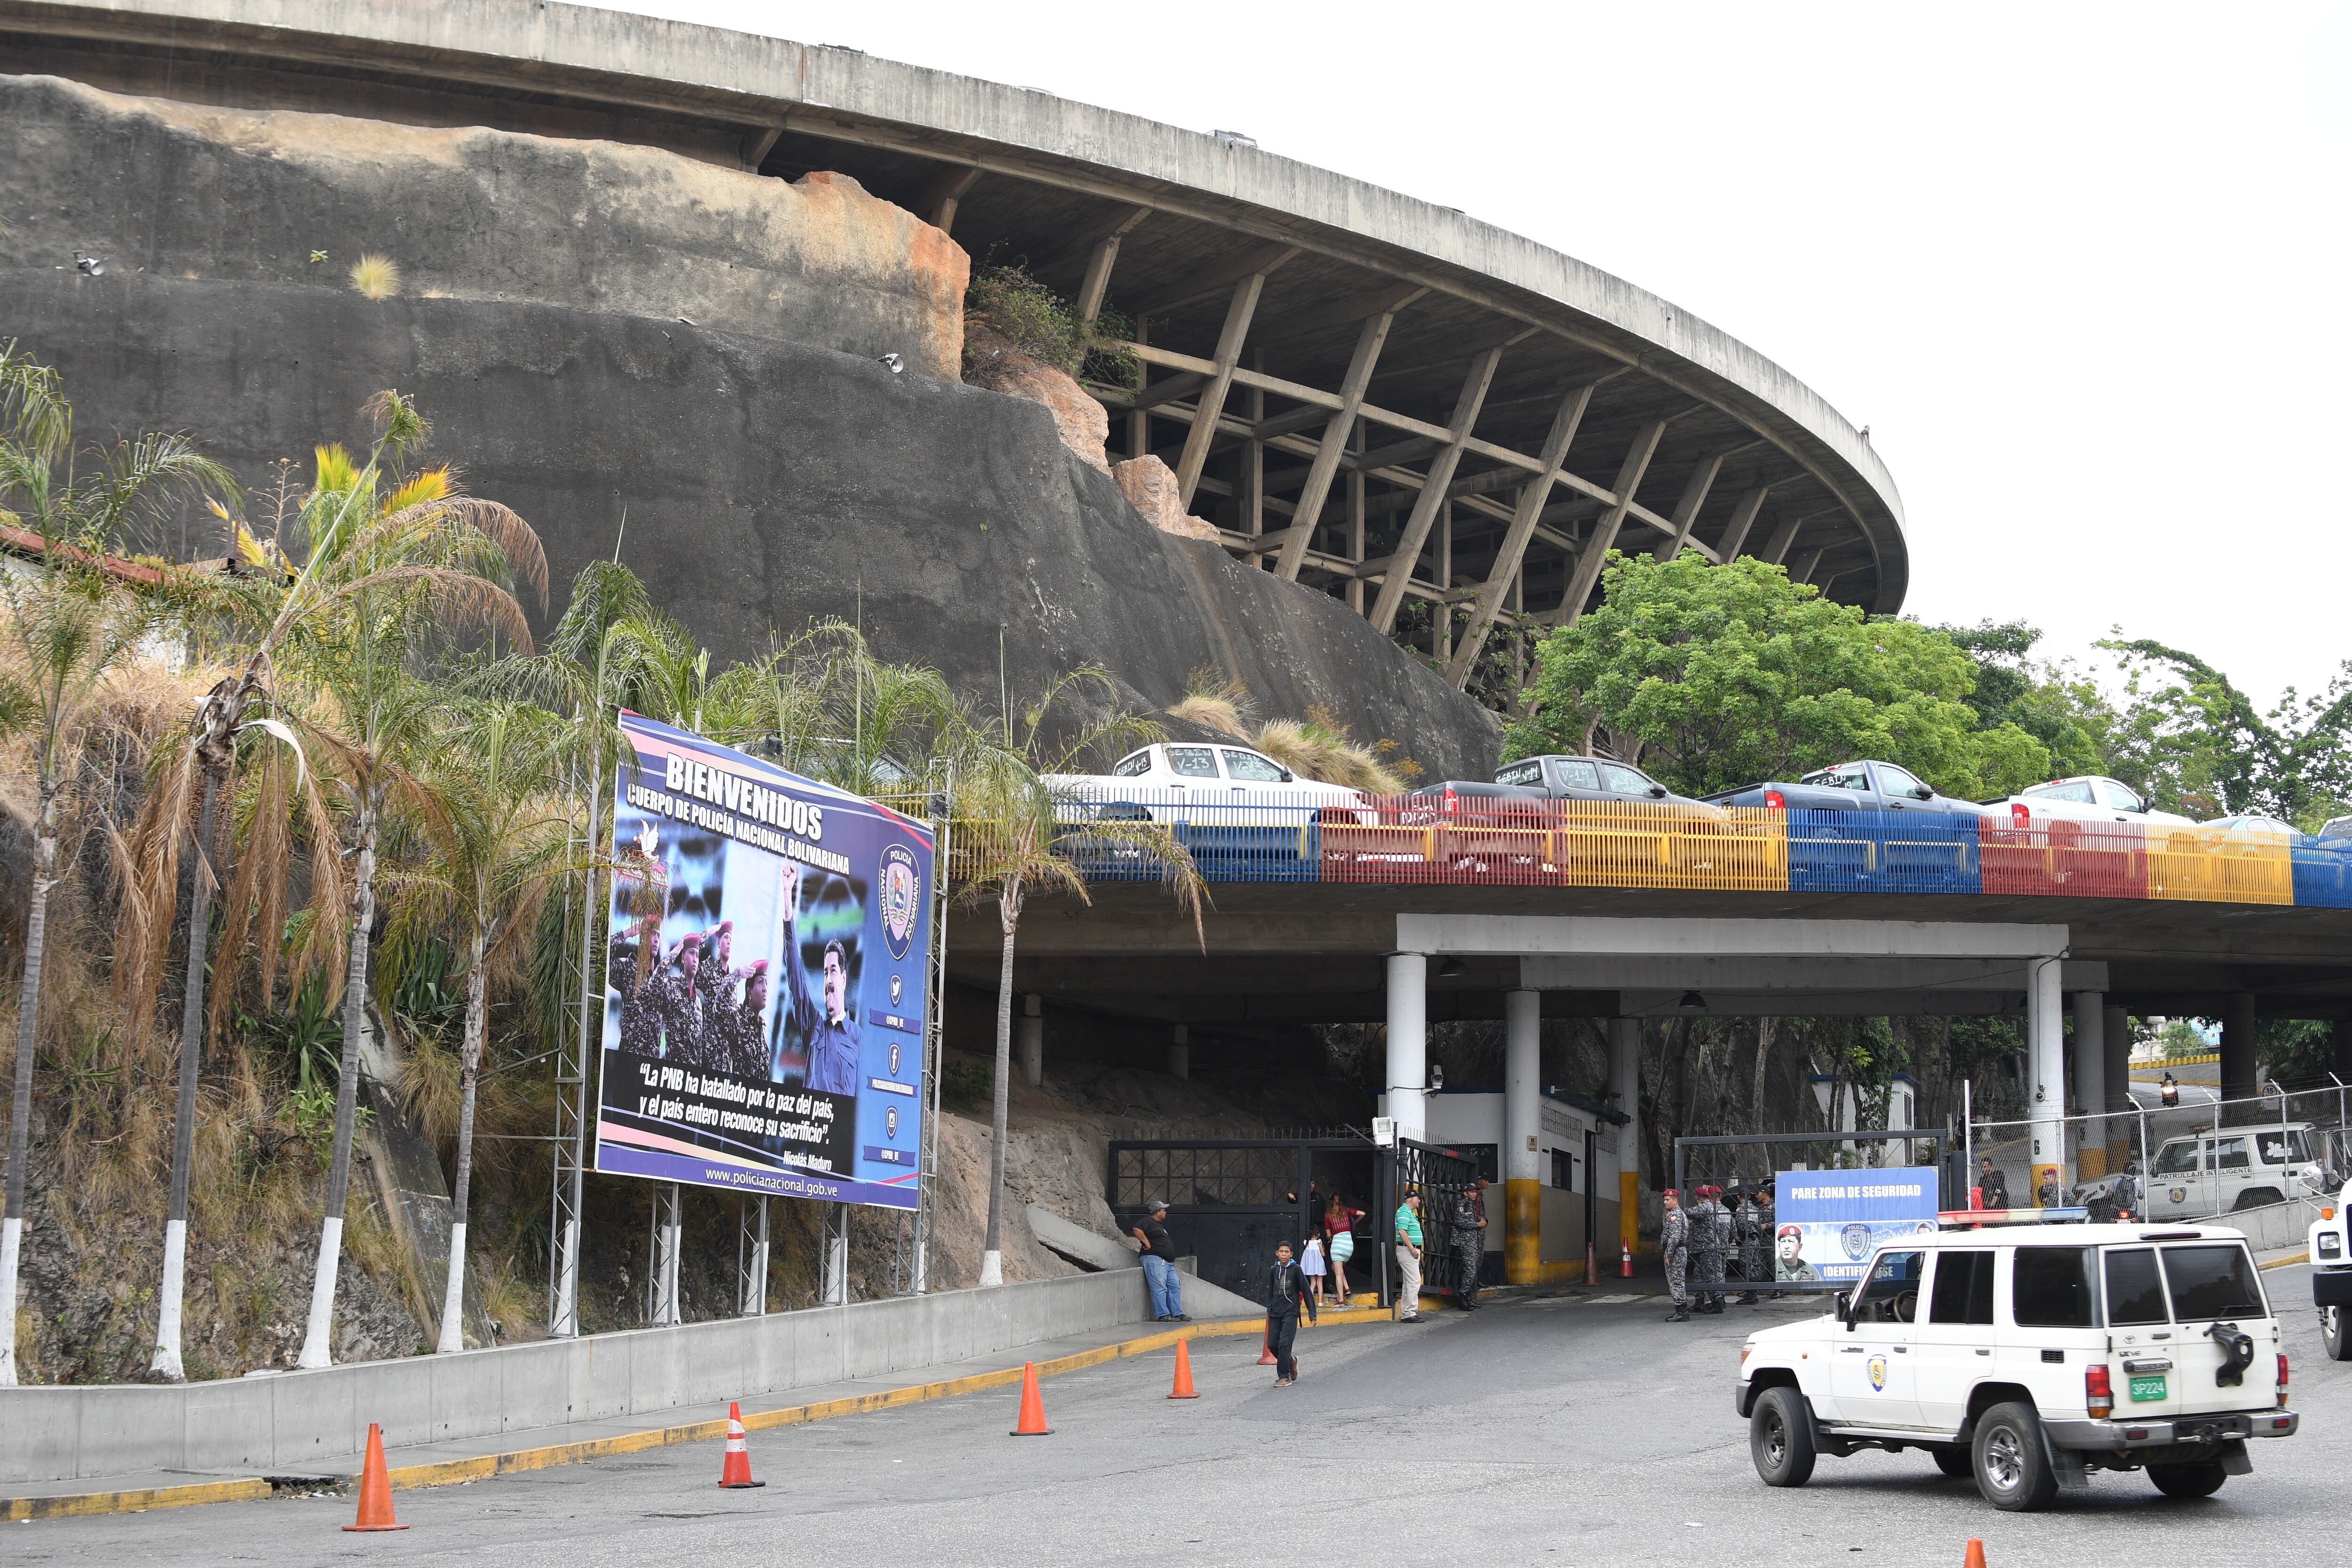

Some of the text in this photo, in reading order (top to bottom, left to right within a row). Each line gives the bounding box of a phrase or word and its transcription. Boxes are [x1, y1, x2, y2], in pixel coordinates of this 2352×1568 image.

[1135, 756, 1147, 772] V-13
[1177, 757, 1209, 769] V-13
[1496, 767, 1520, 784] SEBIN
[1562, 769, 1589, 783] V-14
[1812, 775, 1846, 786] SEBIN
[666, 752, 822, 840] BIENVENIDOS
[627, 783, 850, 875] CUERPO DE POLICÍA NACIONAL BOLIVARIANA
[881, 868, 891, 931] NACIONAL
[905, 876, 919, 941] BOLIVARIANA
[660, 1066, 684, 1091] PNB
[684, 1071, 699, 1094] ha
[700, 1074, 747, 1103] batallado
[747, 1088, 765, 1109] por
[765, 1088, 775, 1109] la
[776, 1094, 795, 1114] paz
[796, 1094, 812, 1115] del
[811, 1098, 834, 1123] país,
[638, 1096, 647, 1118] y
[648, 1094, 660, 1115] el
[660, 1097, 684, 1122] país
[685, 1102, 719, 1126] entero
[720, 1110, 764, 1134] reconoce
[765, 1119, 778, 1136] su
[2034, 1139, 2040, 1155] 6
[783, 1150, 832, 1171] Nicolás Maduro
[706, 1169, 837, 1196] www.policianacional.gob.ve
[2160, 1167, 2253, 1179] PATRULLAJE INTELIGENTE
[1791, 1184, 1921, 1199] PARE ZONA DE SEGURIDAD
[1842, 1234, 1852, 1257] NACIONAL
[2132, 1382, 2165, 1395] 3P224
